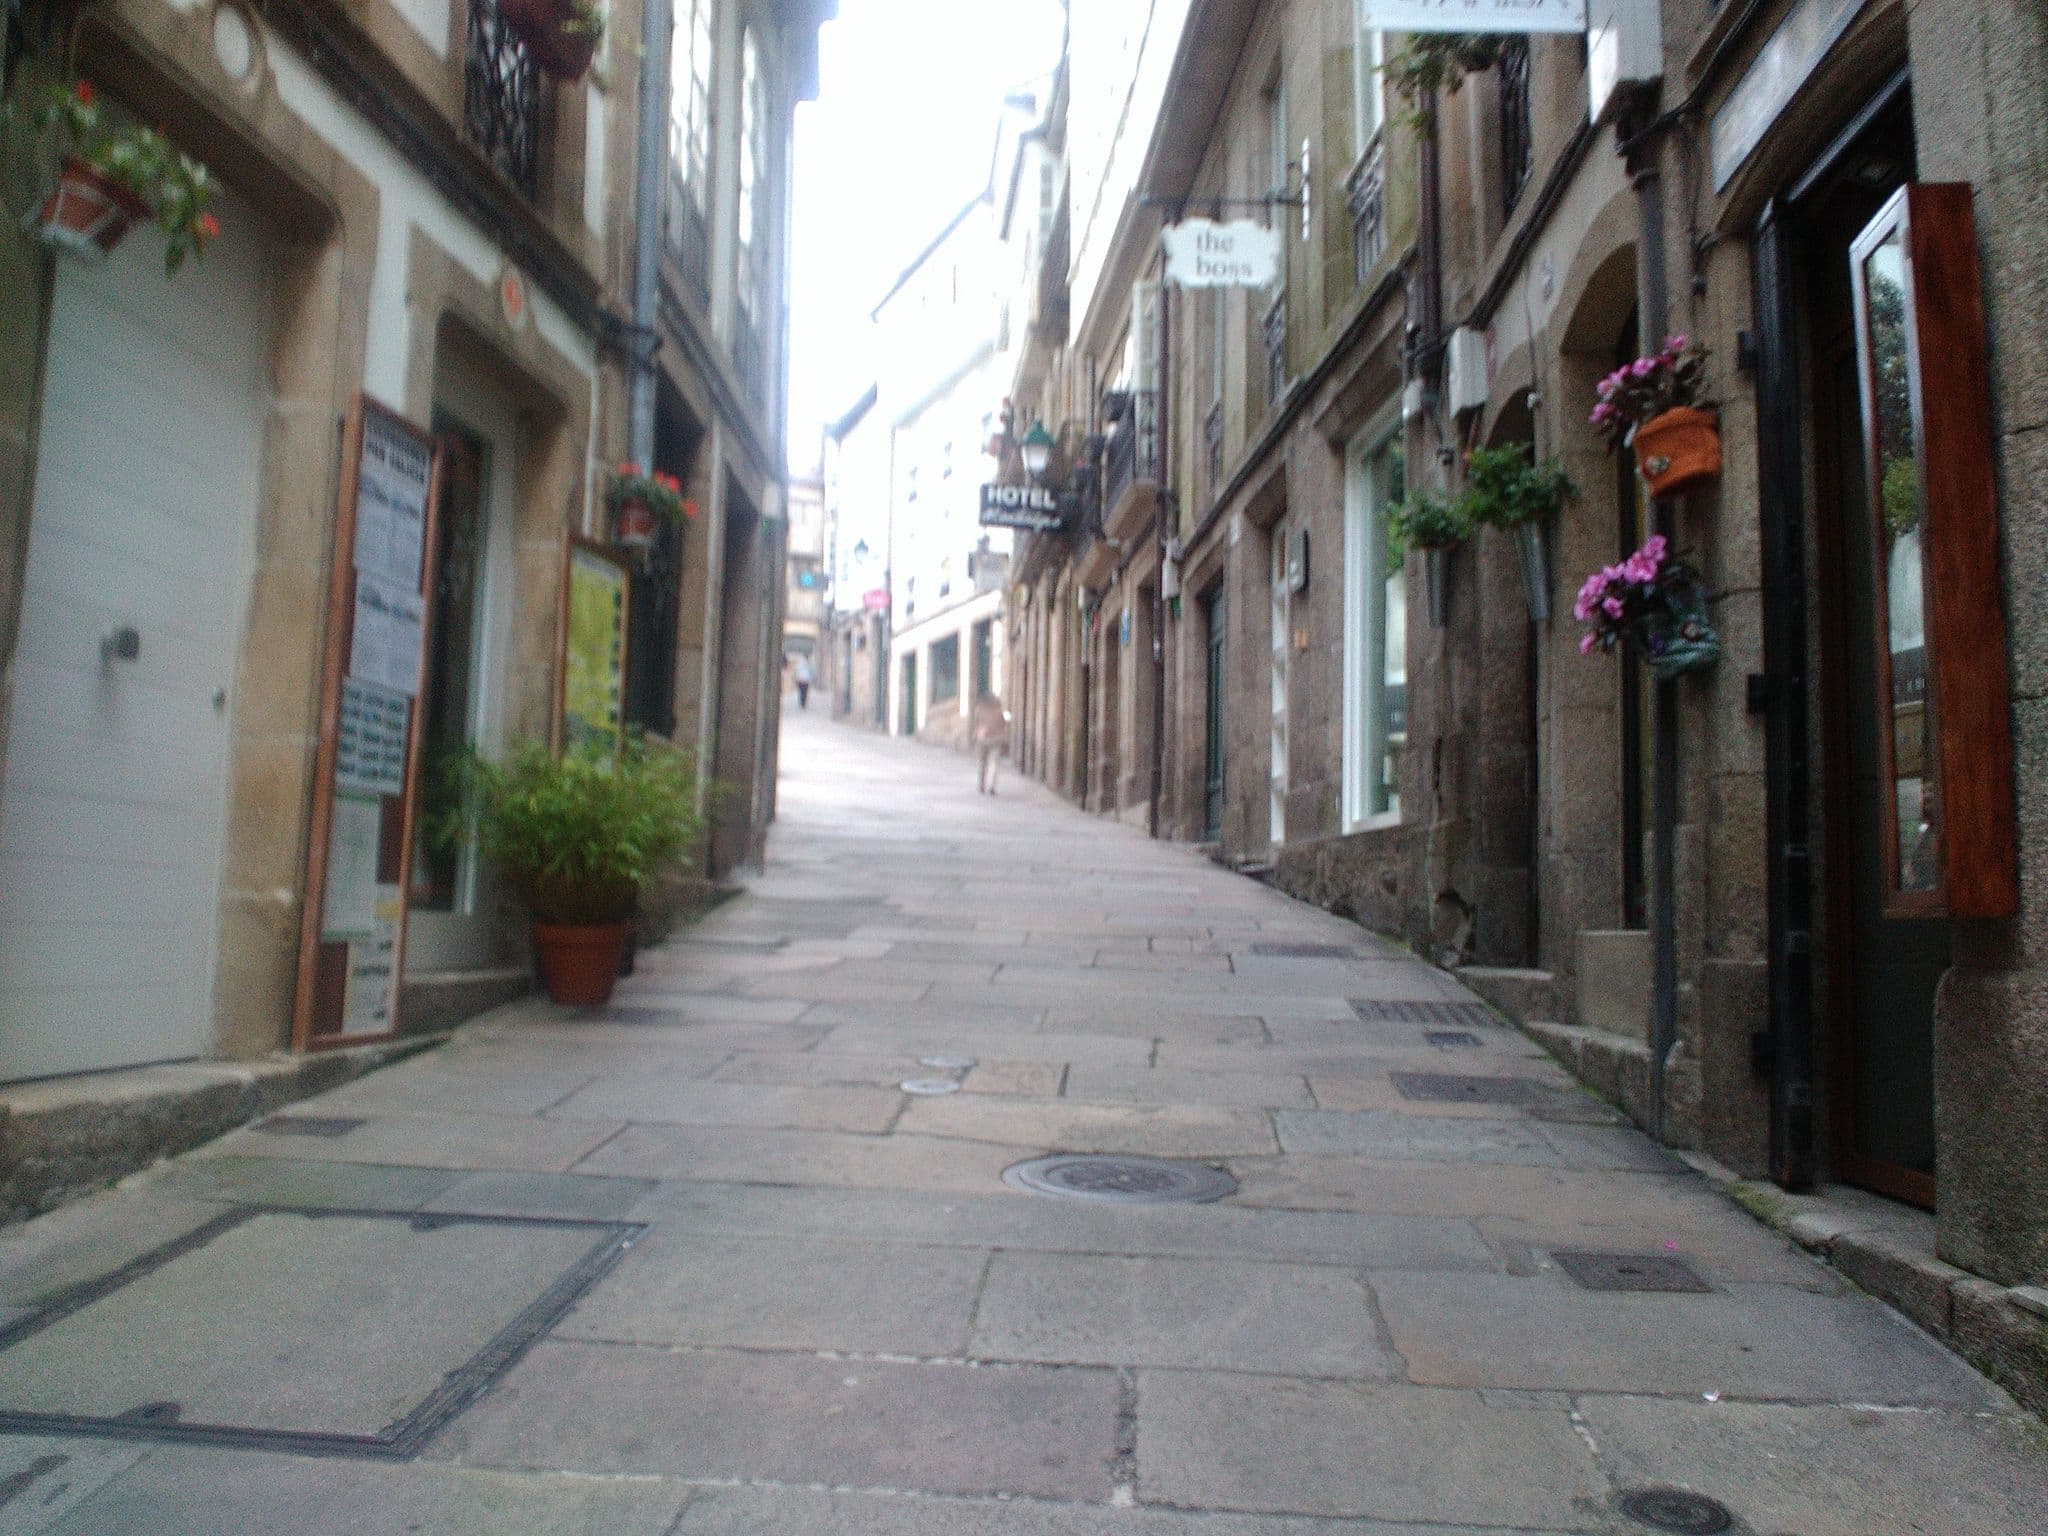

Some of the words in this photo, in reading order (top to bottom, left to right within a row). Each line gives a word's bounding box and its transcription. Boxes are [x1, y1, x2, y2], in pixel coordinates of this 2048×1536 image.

[1196, 231, 1233, 252] the
[1196, 254, 1252, 277] boss
[987, 485, 1057, 510] HOTEL
